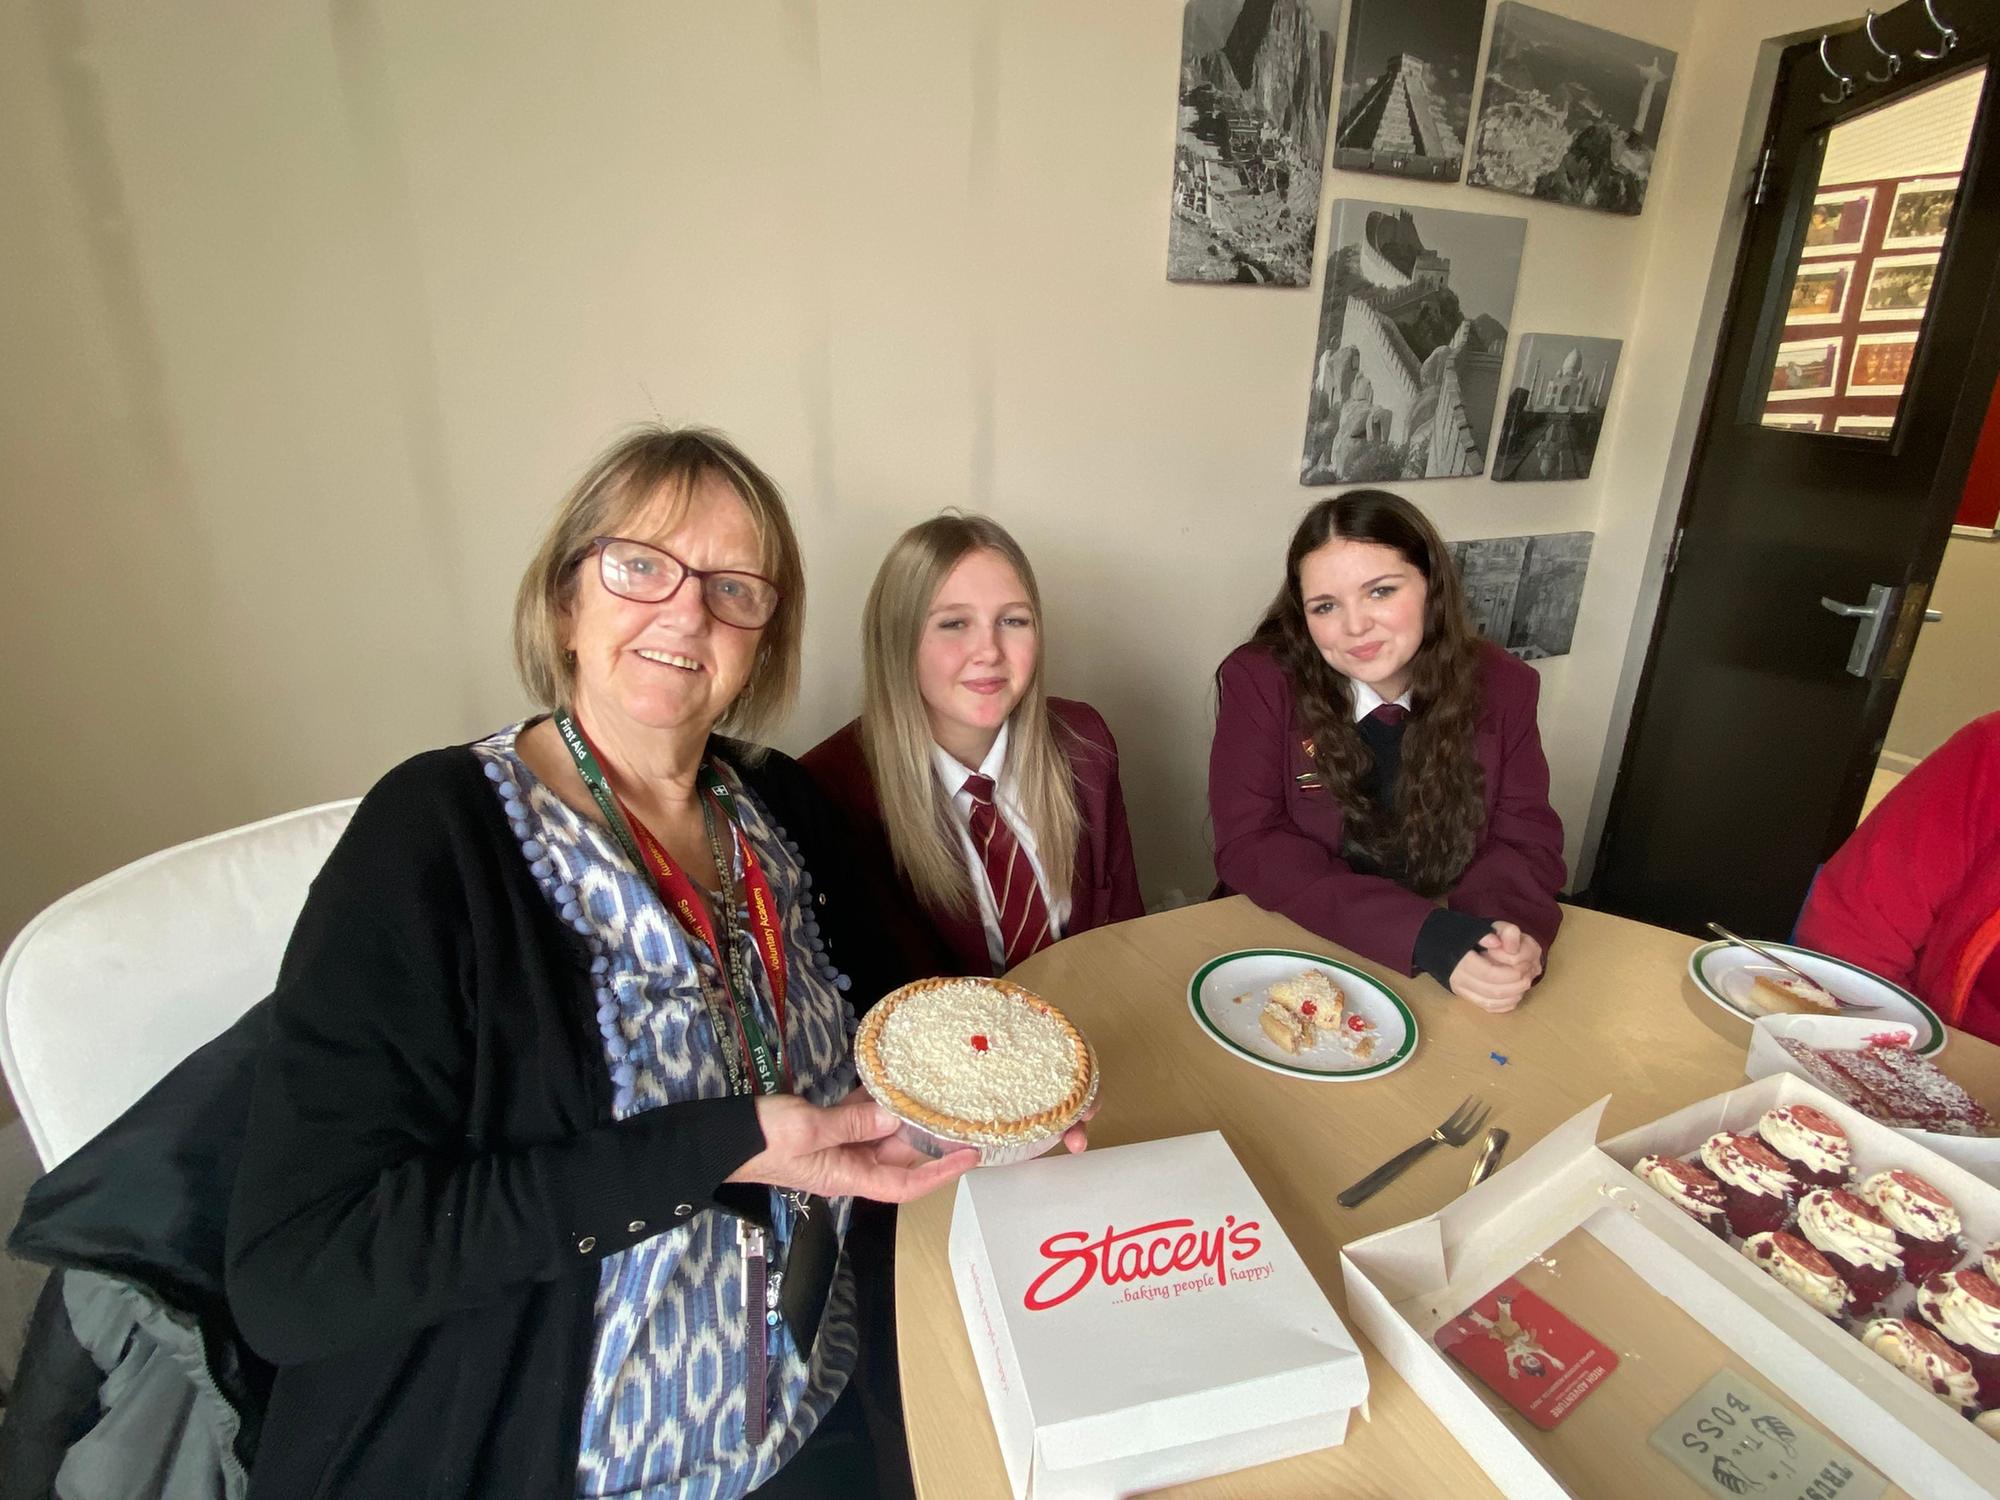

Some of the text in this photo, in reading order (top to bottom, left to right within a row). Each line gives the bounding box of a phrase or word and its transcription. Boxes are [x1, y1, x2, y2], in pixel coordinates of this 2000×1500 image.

[560, 717, 587, 760] First Aid
[677, 899, 697, 926] Saint
[753, 887, 769, 927] Academy
[764, 928, 780, 971] Voluntary
[754, 1045, 778, 1095] First Ai
[1024, 1215, 1262, 1311] Stacey's
[1173, 1271, 1215, 1297] people
[1229, 1261, 1275, 1284] happy!
[1586, 1366, 1606, 1384] HIGH
[1550, 1381, 1589, 1418] ADVENTURE
[1682, 1393, 1750, 1453] BOSS
[1796, 1460, 1854, 1500] TRUS
